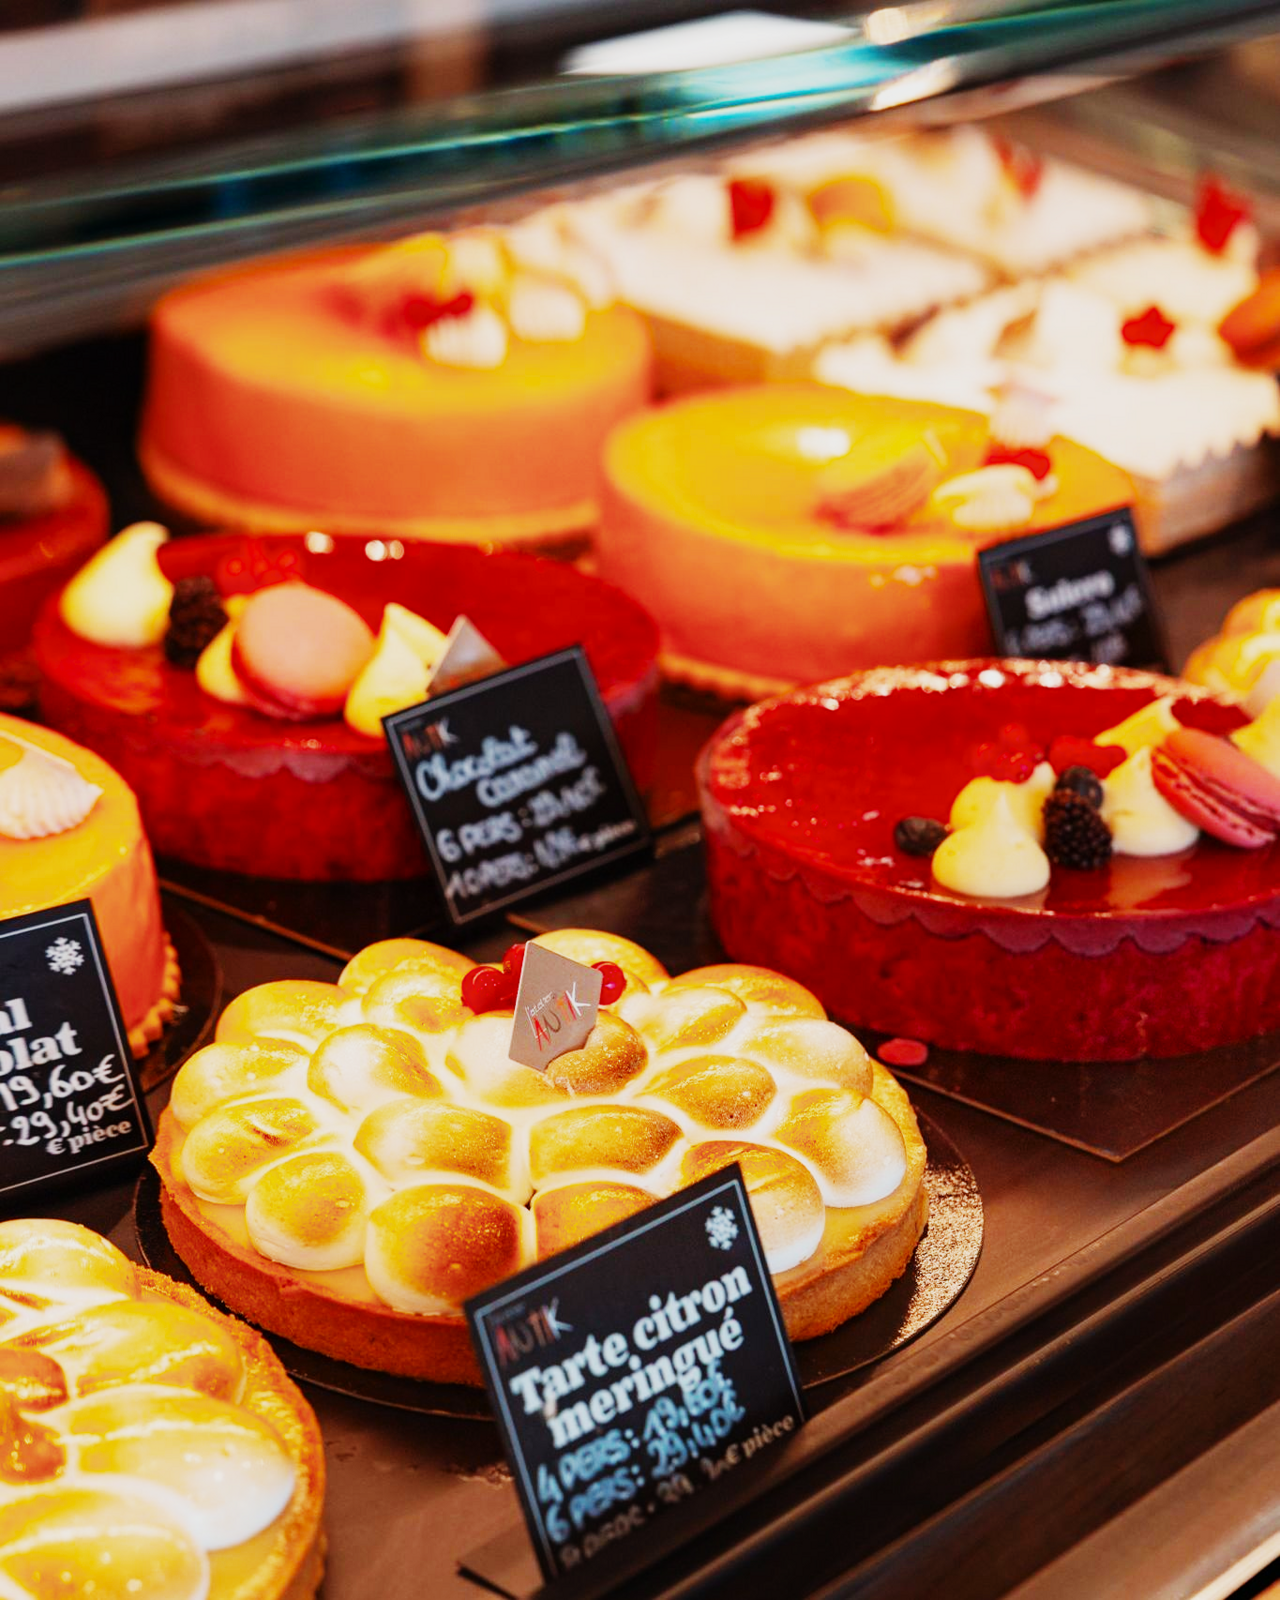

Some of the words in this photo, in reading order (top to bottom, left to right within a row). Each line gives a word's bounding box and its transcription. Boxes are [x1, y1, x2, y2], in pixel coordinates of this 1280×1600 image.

[436, 829, 462, 862] 6
[68, 1119, 132, 1154] pièce
[509, 1332, 629, 1415] Tarte
[633, 1265, 753, 1351] citron
[546, 1307, 744, 1449] meringué
[741, 1414, 795, 1459] pièce
[537, 1463, 564, 1503] 4
[546, 1501, 570, 1544] 6
